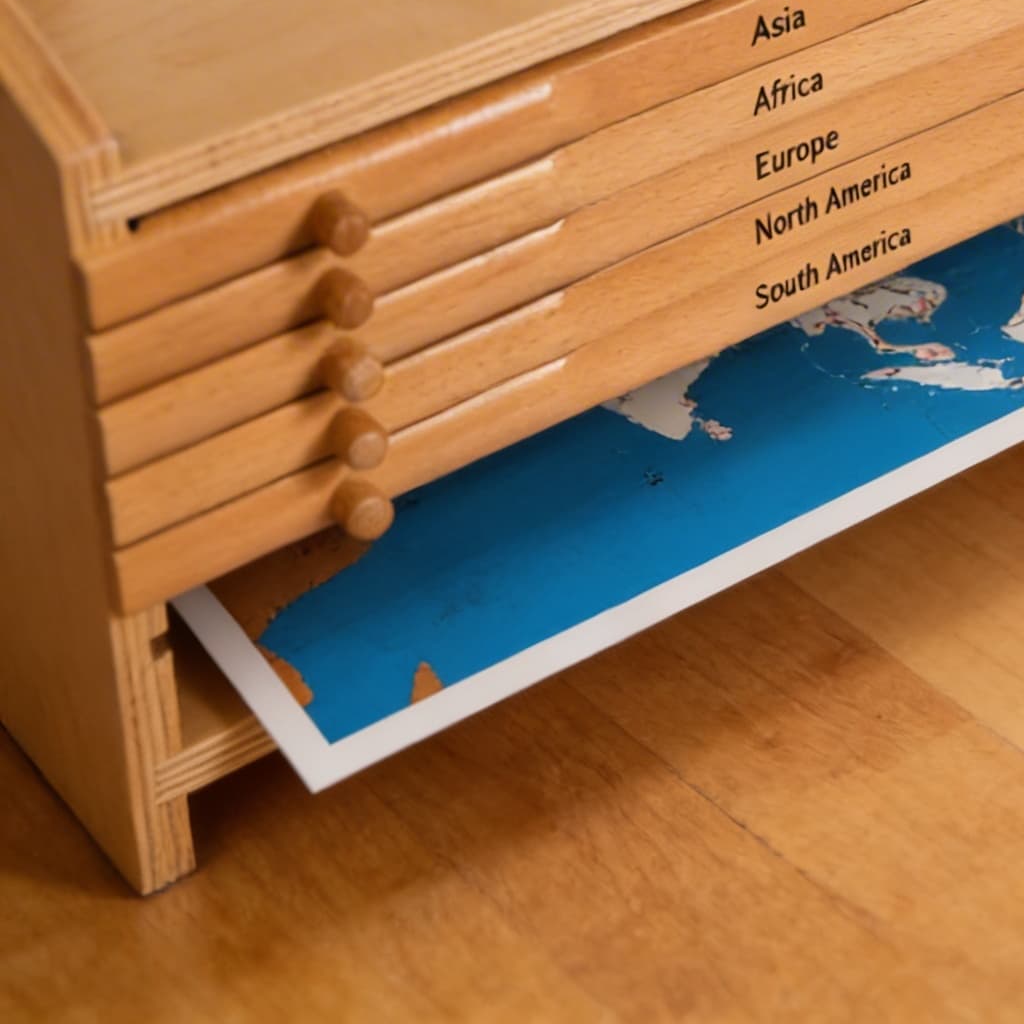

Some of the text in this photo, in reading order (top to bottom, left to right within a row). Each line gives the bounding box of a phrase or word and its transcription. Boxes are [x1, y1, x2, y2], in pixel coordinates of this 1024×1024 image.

[751, 7, 806, 46] Asia
[753, 72, 824, 116] Africa
[755, 130, 839, 180] Europe
[754, 162, 911, 245] North America
[755, 228, 911, 310] South America
